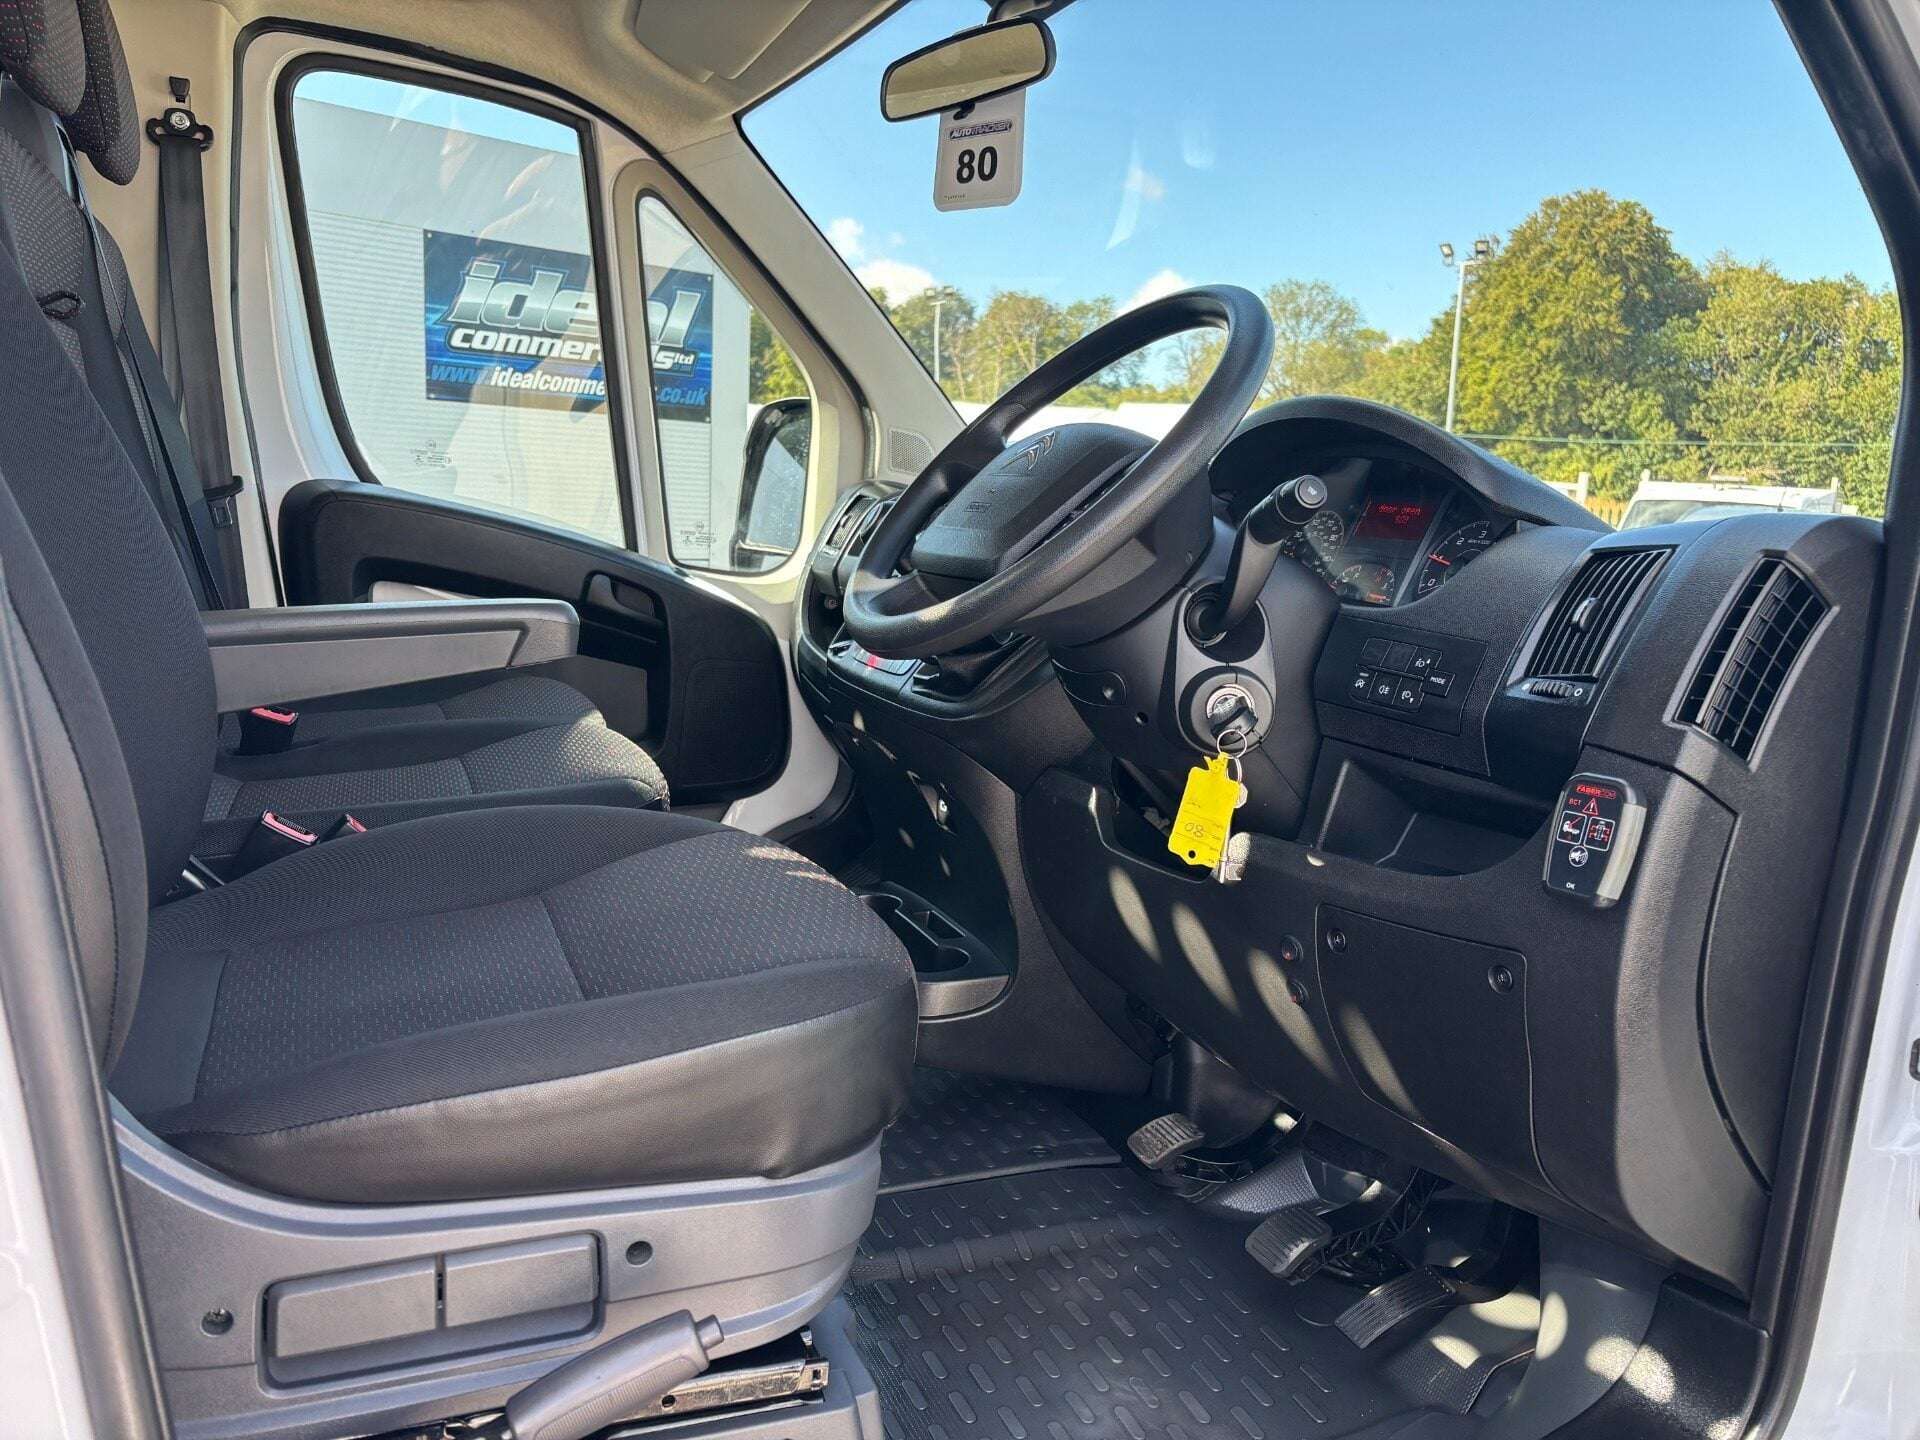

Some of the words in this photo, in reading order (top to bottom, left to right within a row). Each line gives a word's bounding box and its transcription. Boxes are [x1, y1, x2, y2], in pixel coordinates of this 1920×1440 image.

[957, 146, 998, 184] 80
[449, 327, 674, 369] commerls
[1478, 530, 1487, 538] 3
[1456, 537, 1465, 545] 2
[1427, 578, 1436, 586] 0
[1430, 676, 1446, 685] MODE
[1566, 882, 1576, 890] OK
